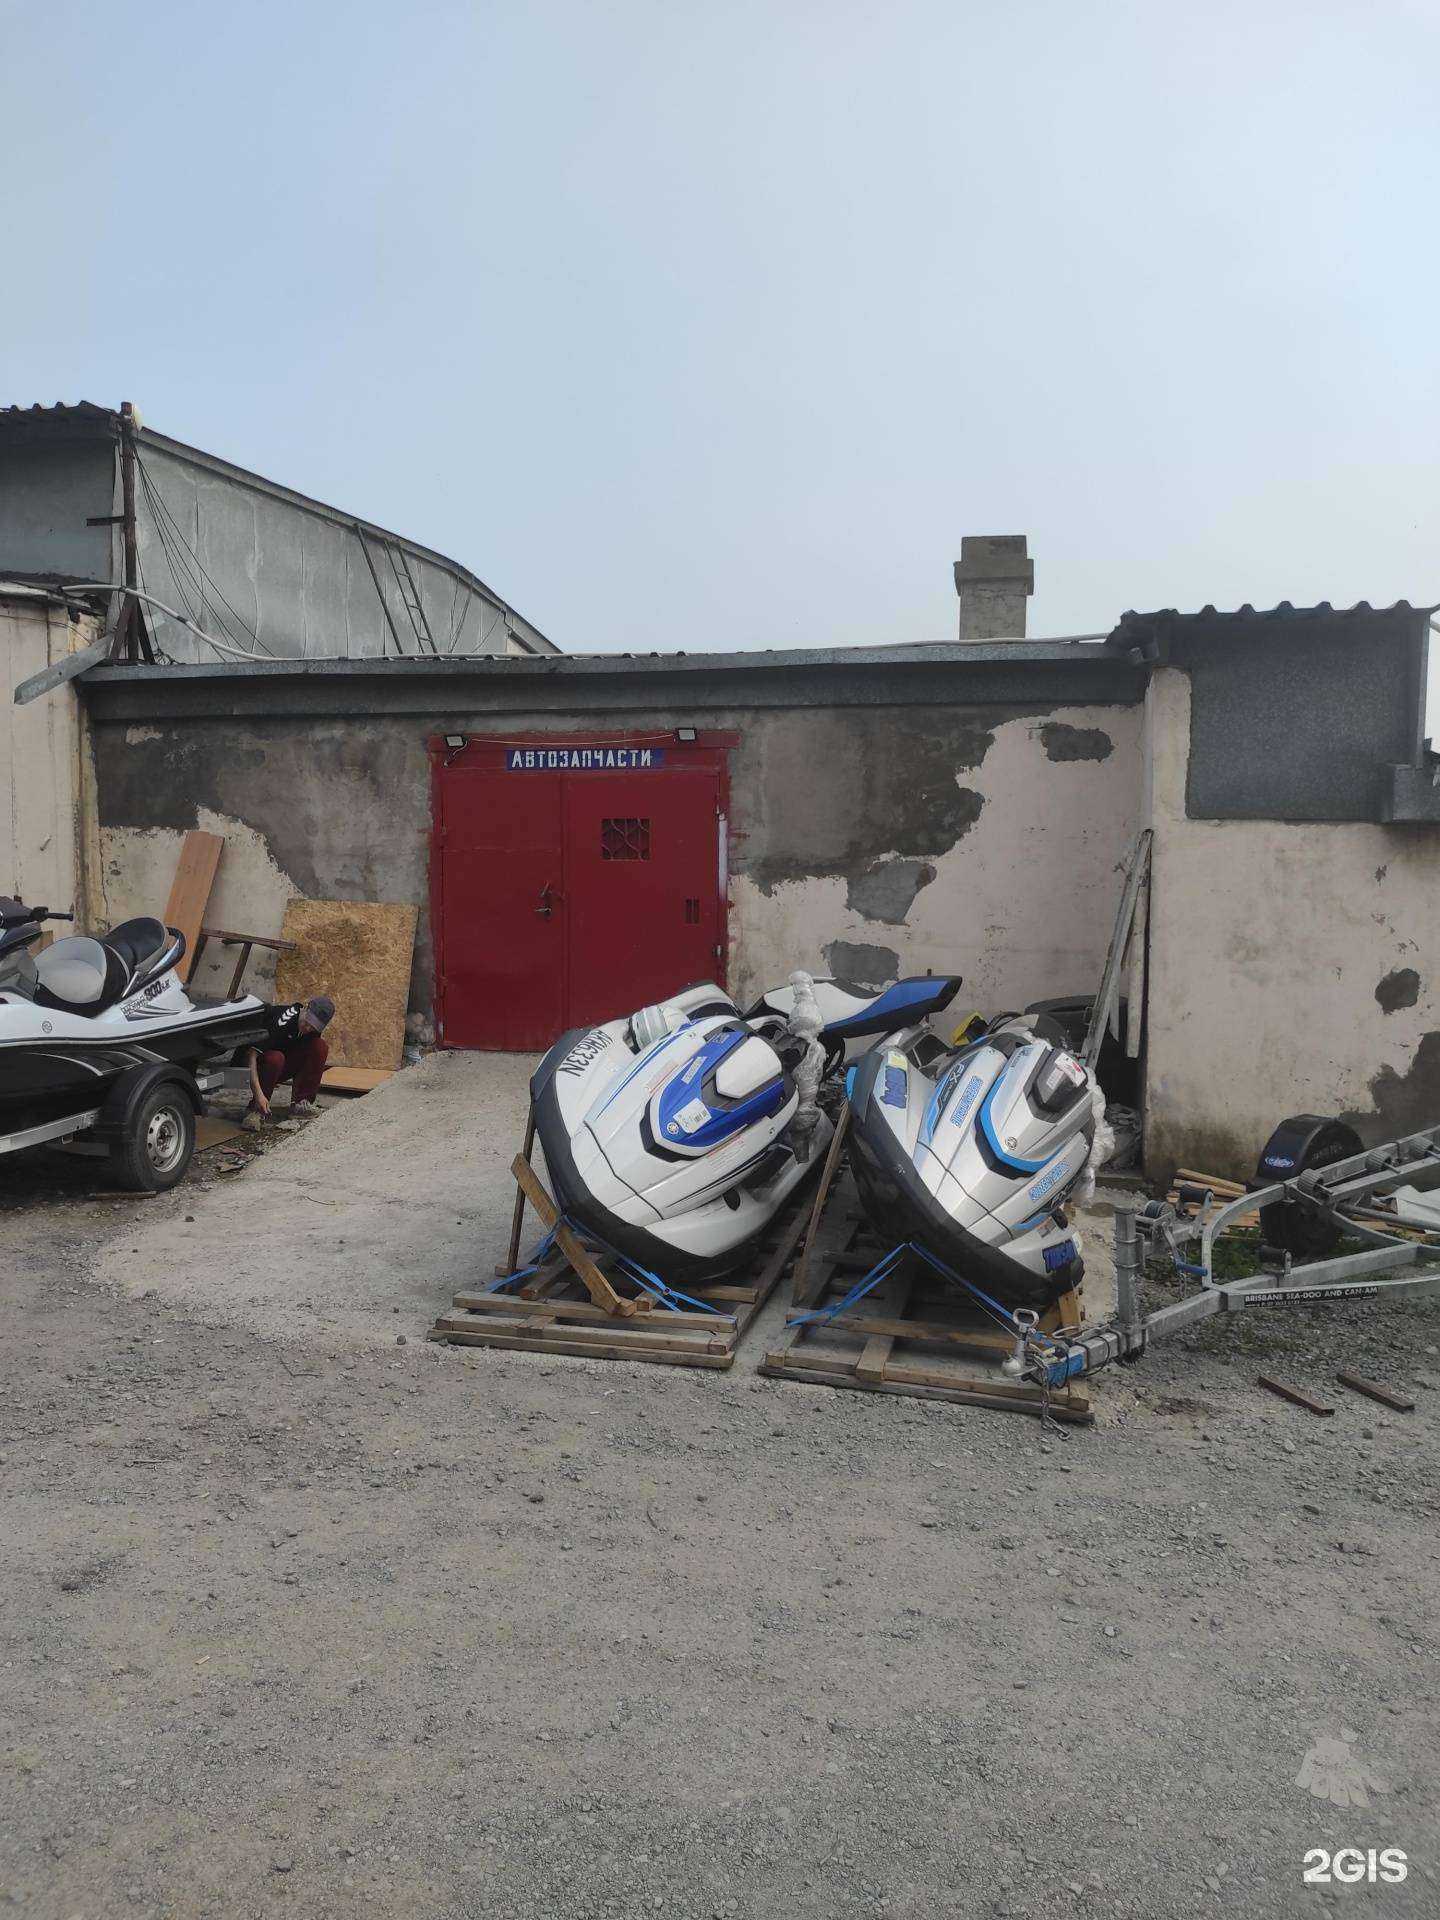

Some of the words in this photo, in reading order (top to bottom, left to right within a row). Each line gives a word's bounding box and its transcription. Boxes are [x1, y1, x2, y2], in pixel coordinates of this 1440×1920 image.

[511, 750, 651, 768] АВТОЗАПЧАСТИ
[1245, 1293, 1284, 1302] BRISBANE
[1286, 1291, 1321, 1300] SEA-DOO
[1325, 1289, 1342, 1297] AND
